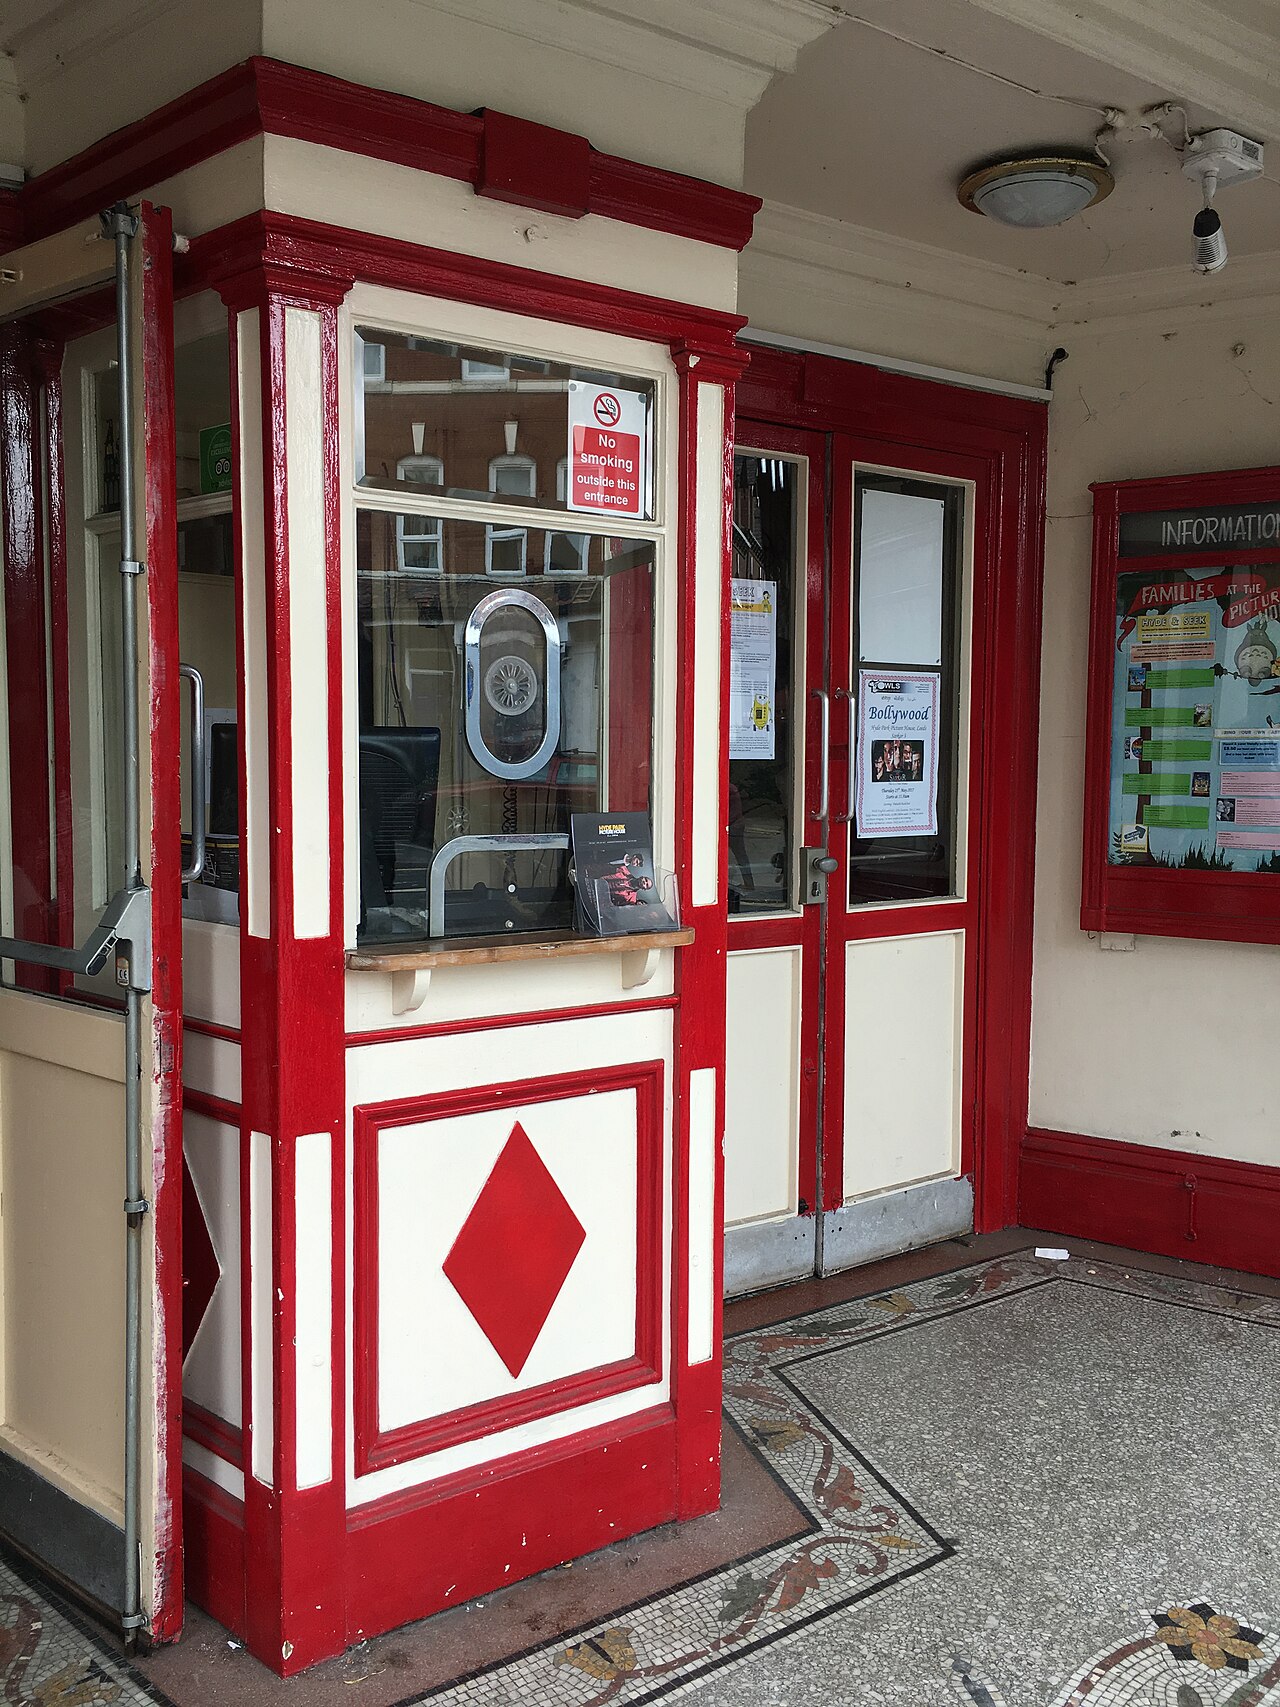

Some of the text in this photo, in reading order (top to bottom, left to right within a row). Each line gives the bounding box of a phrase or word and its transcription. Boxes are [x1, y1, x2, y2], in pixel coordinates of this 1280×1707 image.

[598, 434, 616, 448] No
[580, 453, 633, 472] smoking
[577, 475, 636, 490] outside this
[584, 491, 628, 505] entrance
[1142, 583, 1261, 604] FAMILIES AT THE
[1142, 615, 1207, 627] HYDE & SEEK
[869, 704, 931, 724] Bollywood
